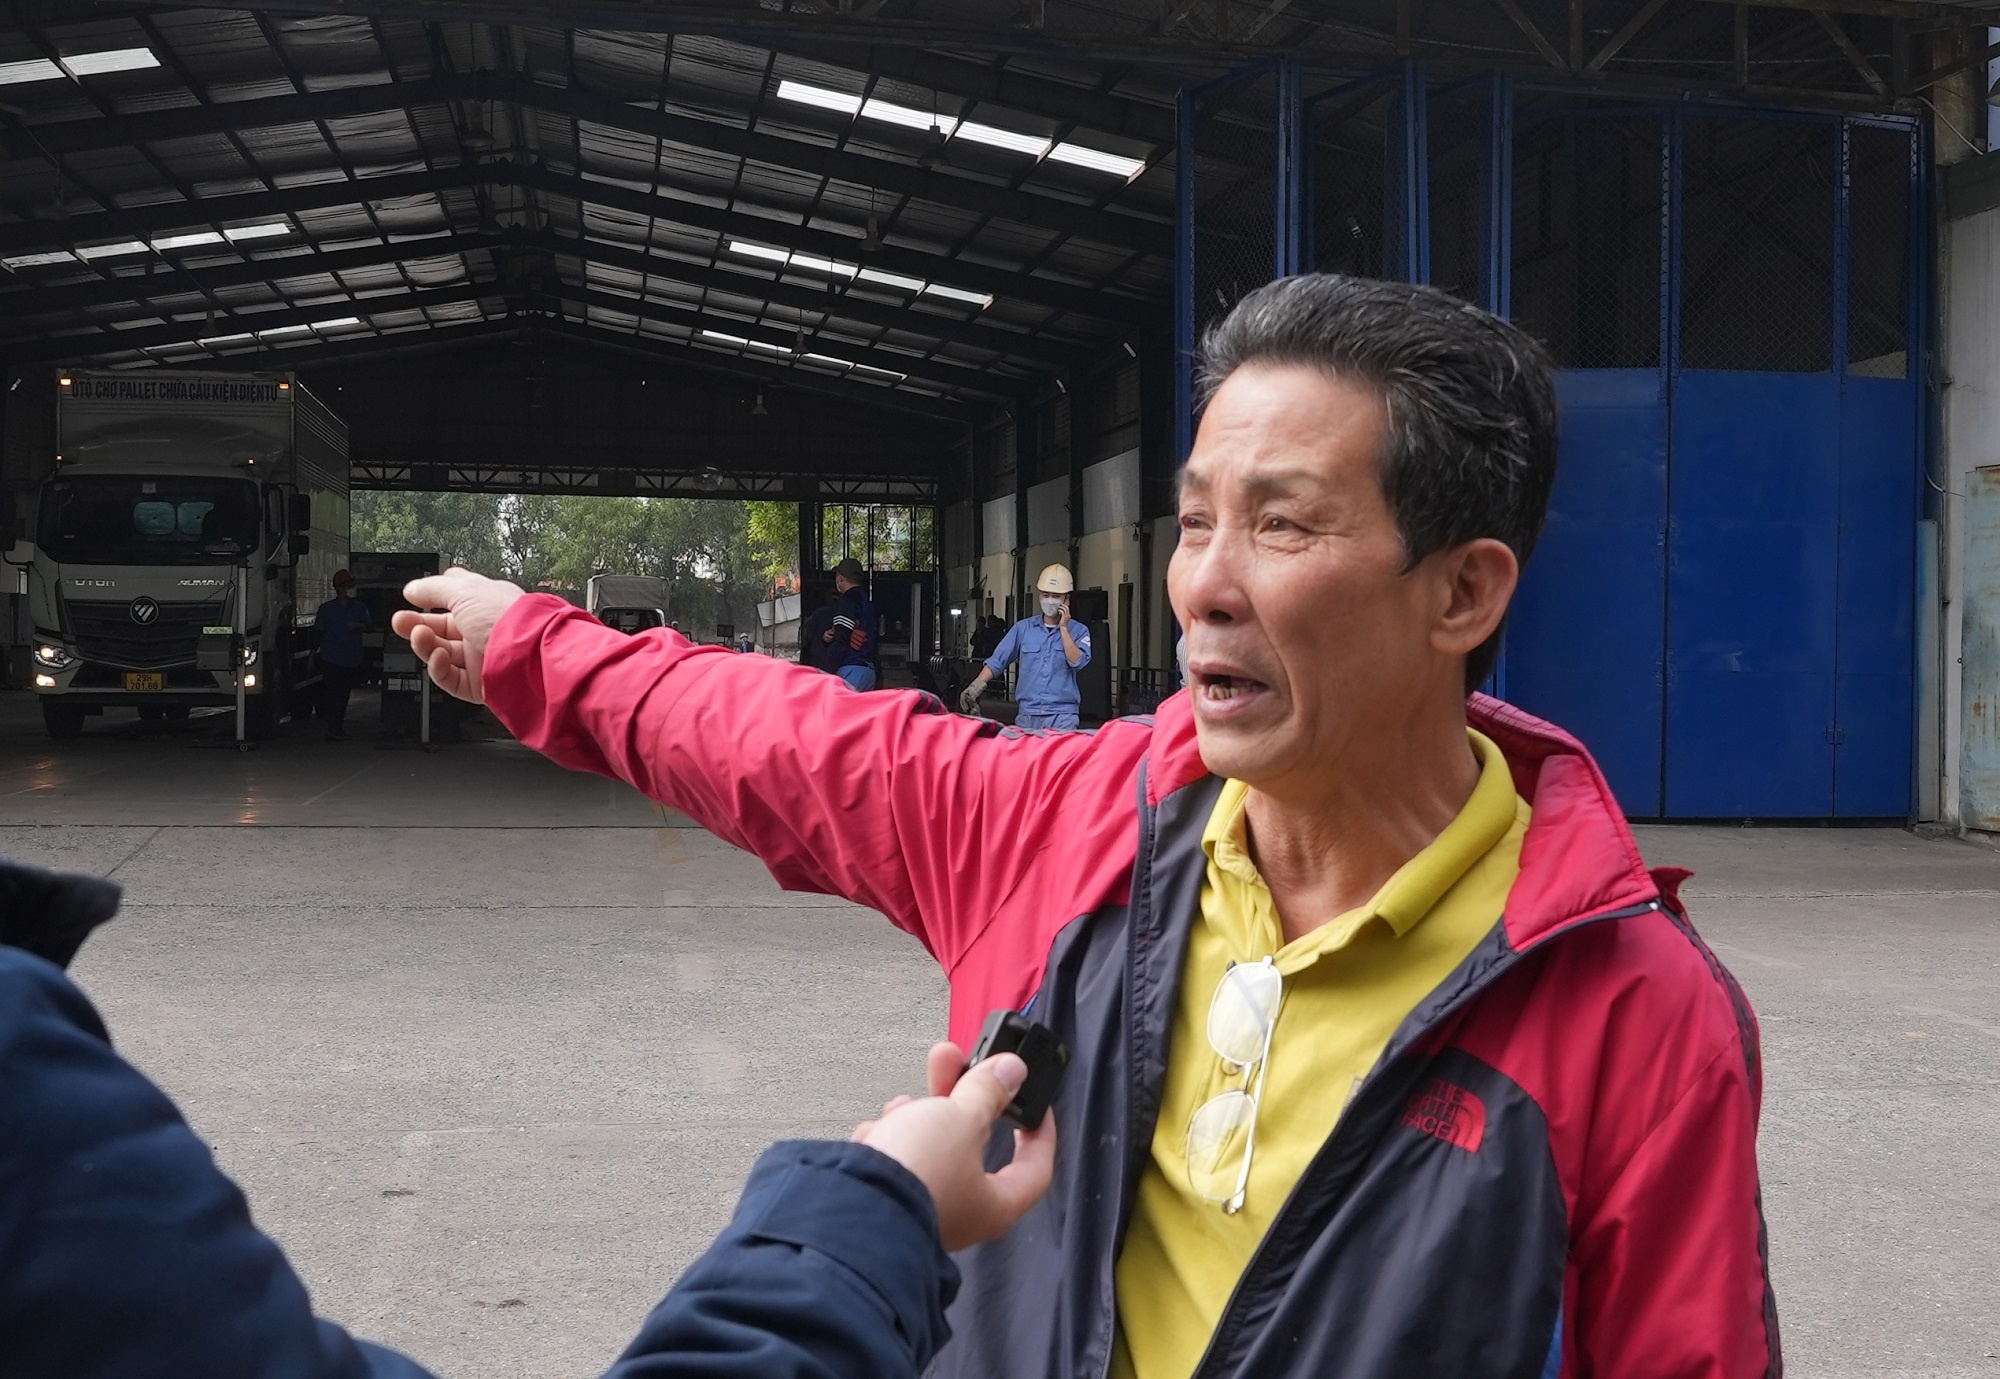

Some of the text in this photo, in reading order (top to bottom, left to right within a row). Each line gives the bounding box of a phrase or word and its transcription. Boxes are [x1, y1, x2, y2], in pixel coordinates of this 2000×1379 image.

[119, 381, 157, 399] PALLET
[1429, 1077, 1462, 1103] THE
[1400, 1109, 1451, 1141] FACE
